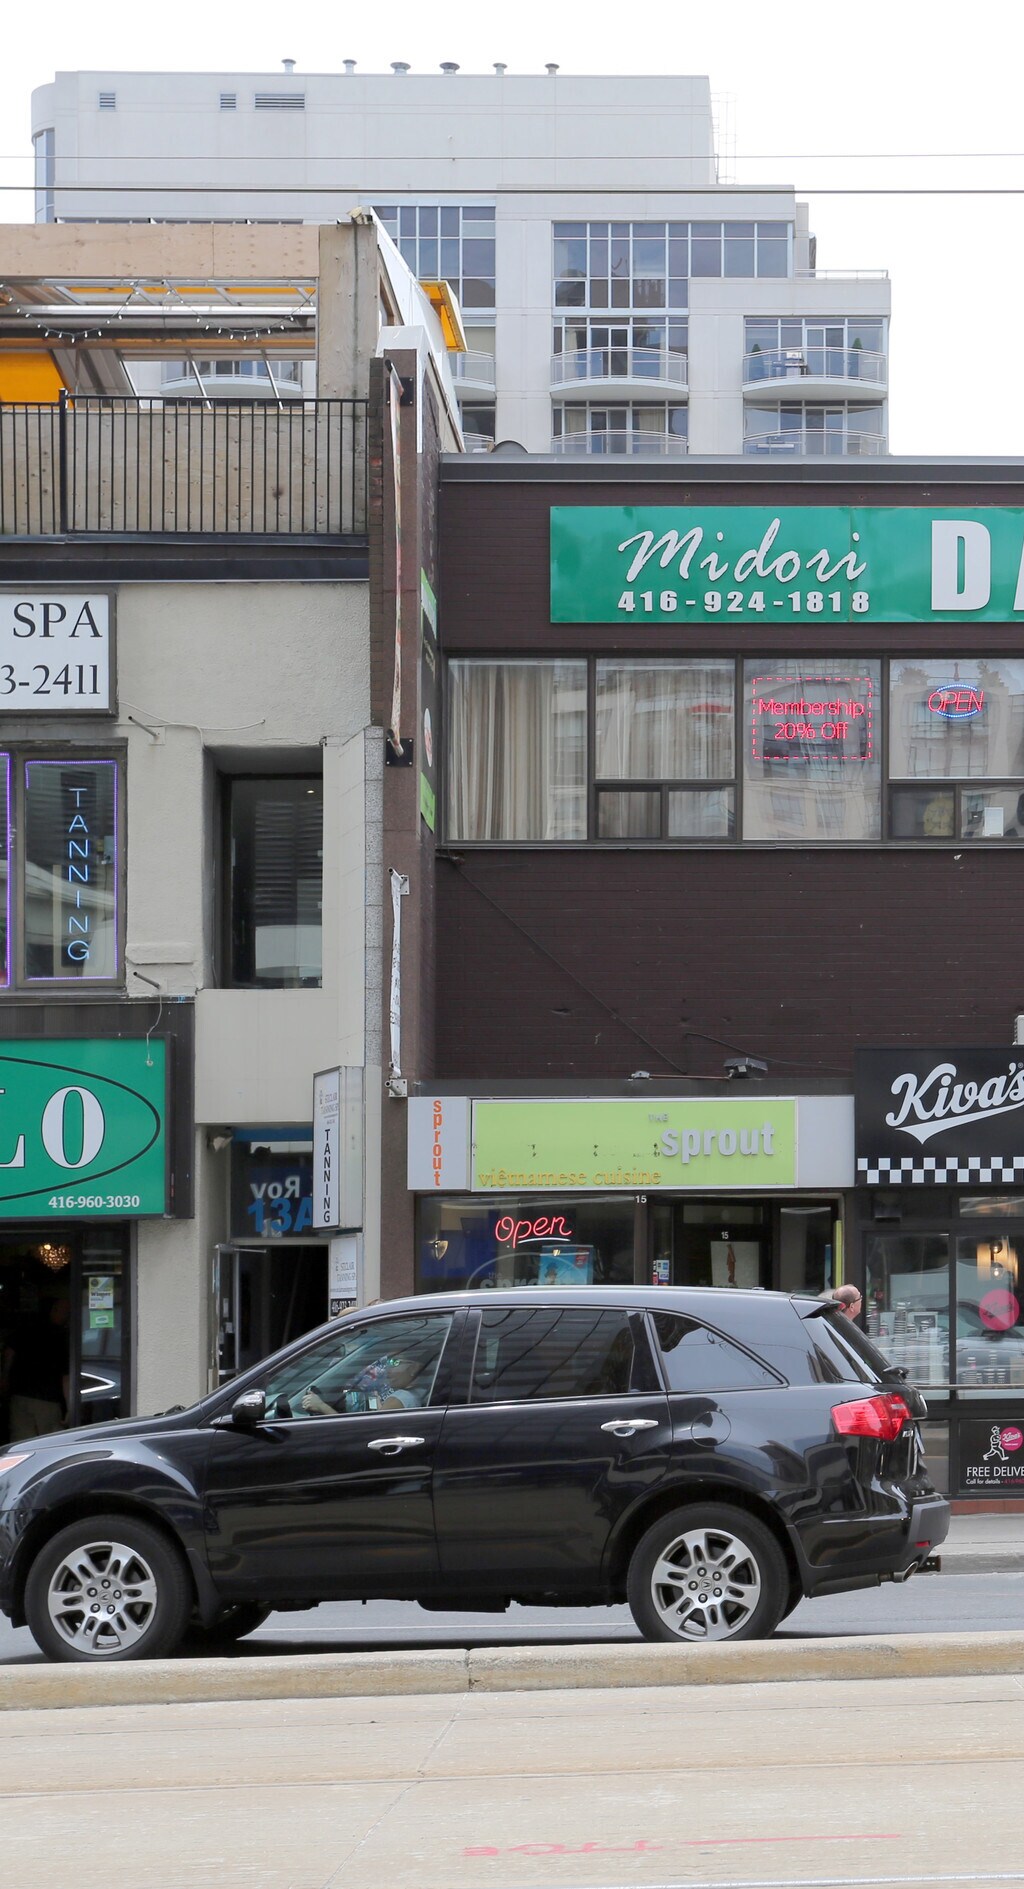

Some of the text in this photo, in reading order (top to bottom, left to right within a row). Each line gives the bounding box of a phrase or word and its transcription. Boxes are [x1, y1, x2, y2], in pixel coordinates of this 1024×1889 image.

[618, 518, 867, 583] Midori
[618, 590, 869, 612] 416-924-1818
[13, 601, 102, 638] SPA
[758, 699, 865, 718] Membership
[928, 690, 984, 712] OPEN
[774, 721, 848, 740] 20% Off
[67, 788, 90, 961] TANNING
[433, 1100, 442, 1186] sprout
[661, 1121, 776, 1164] sprout
[323, 1129, 331, 1223] TANNING
[593, 1166, 661, 1185] cuisine
[48, 1195, 140, 1209] 416-960-3030
[635, 1195, 647, 1203] 15
[495, 1215, 572, 1248] Open
[721, 1231, 729, 1239] 15
[966, 1466, 990, 1477] FREE
